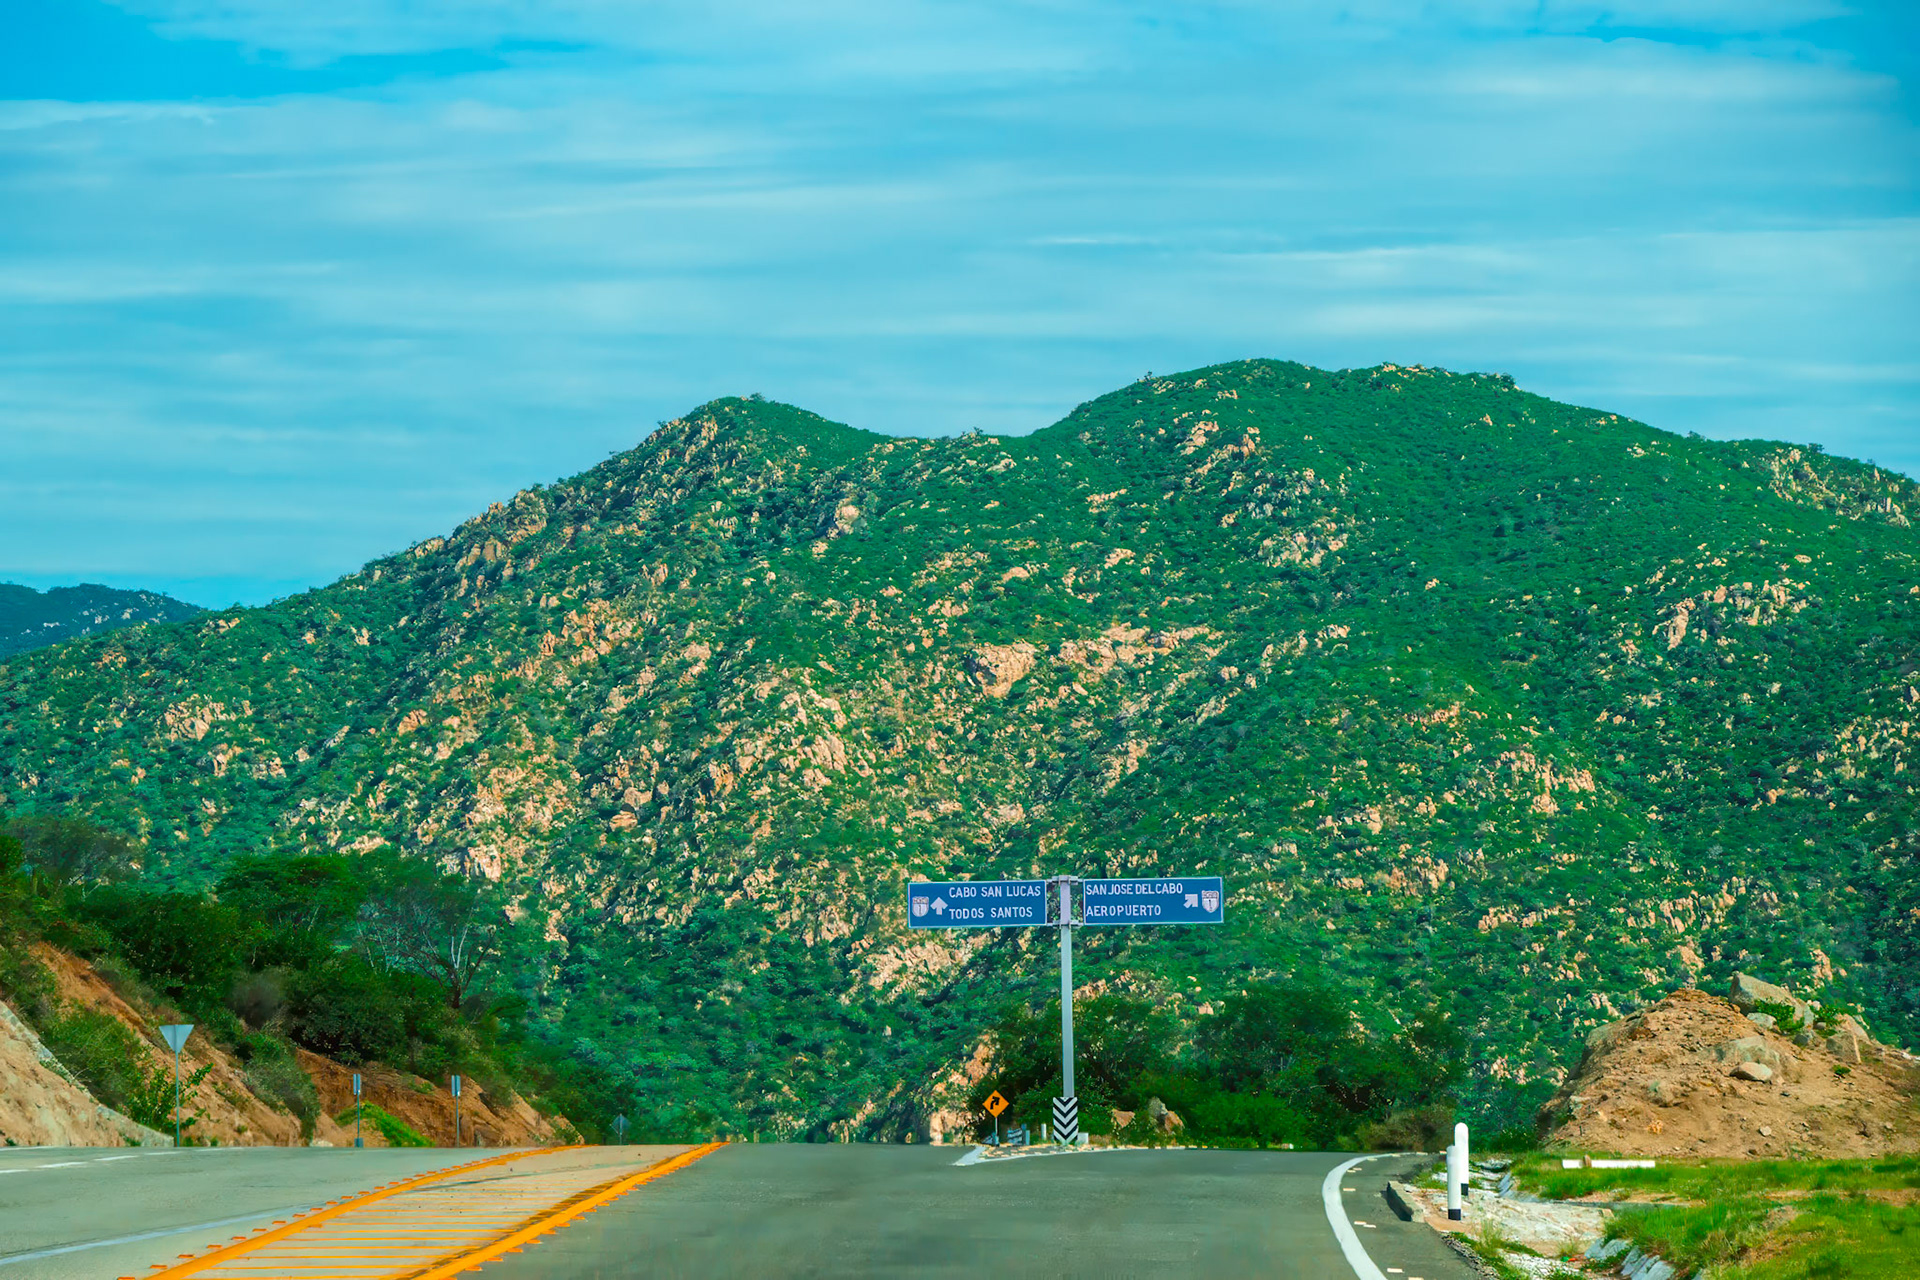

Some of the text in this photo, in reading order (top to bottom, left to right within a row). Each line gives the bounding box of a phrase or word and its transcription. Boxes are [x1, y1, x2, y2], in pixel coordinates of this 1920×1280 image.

[949, 885, 1041, 898] CABO SAN LUCAS
[1086, 883, 1183, 895] SAN JOSE DEL CABO
[949, 906, 1033, 919] TODOS SANTOS
[1086, 904, 1162, 917] AEROPUERTO
